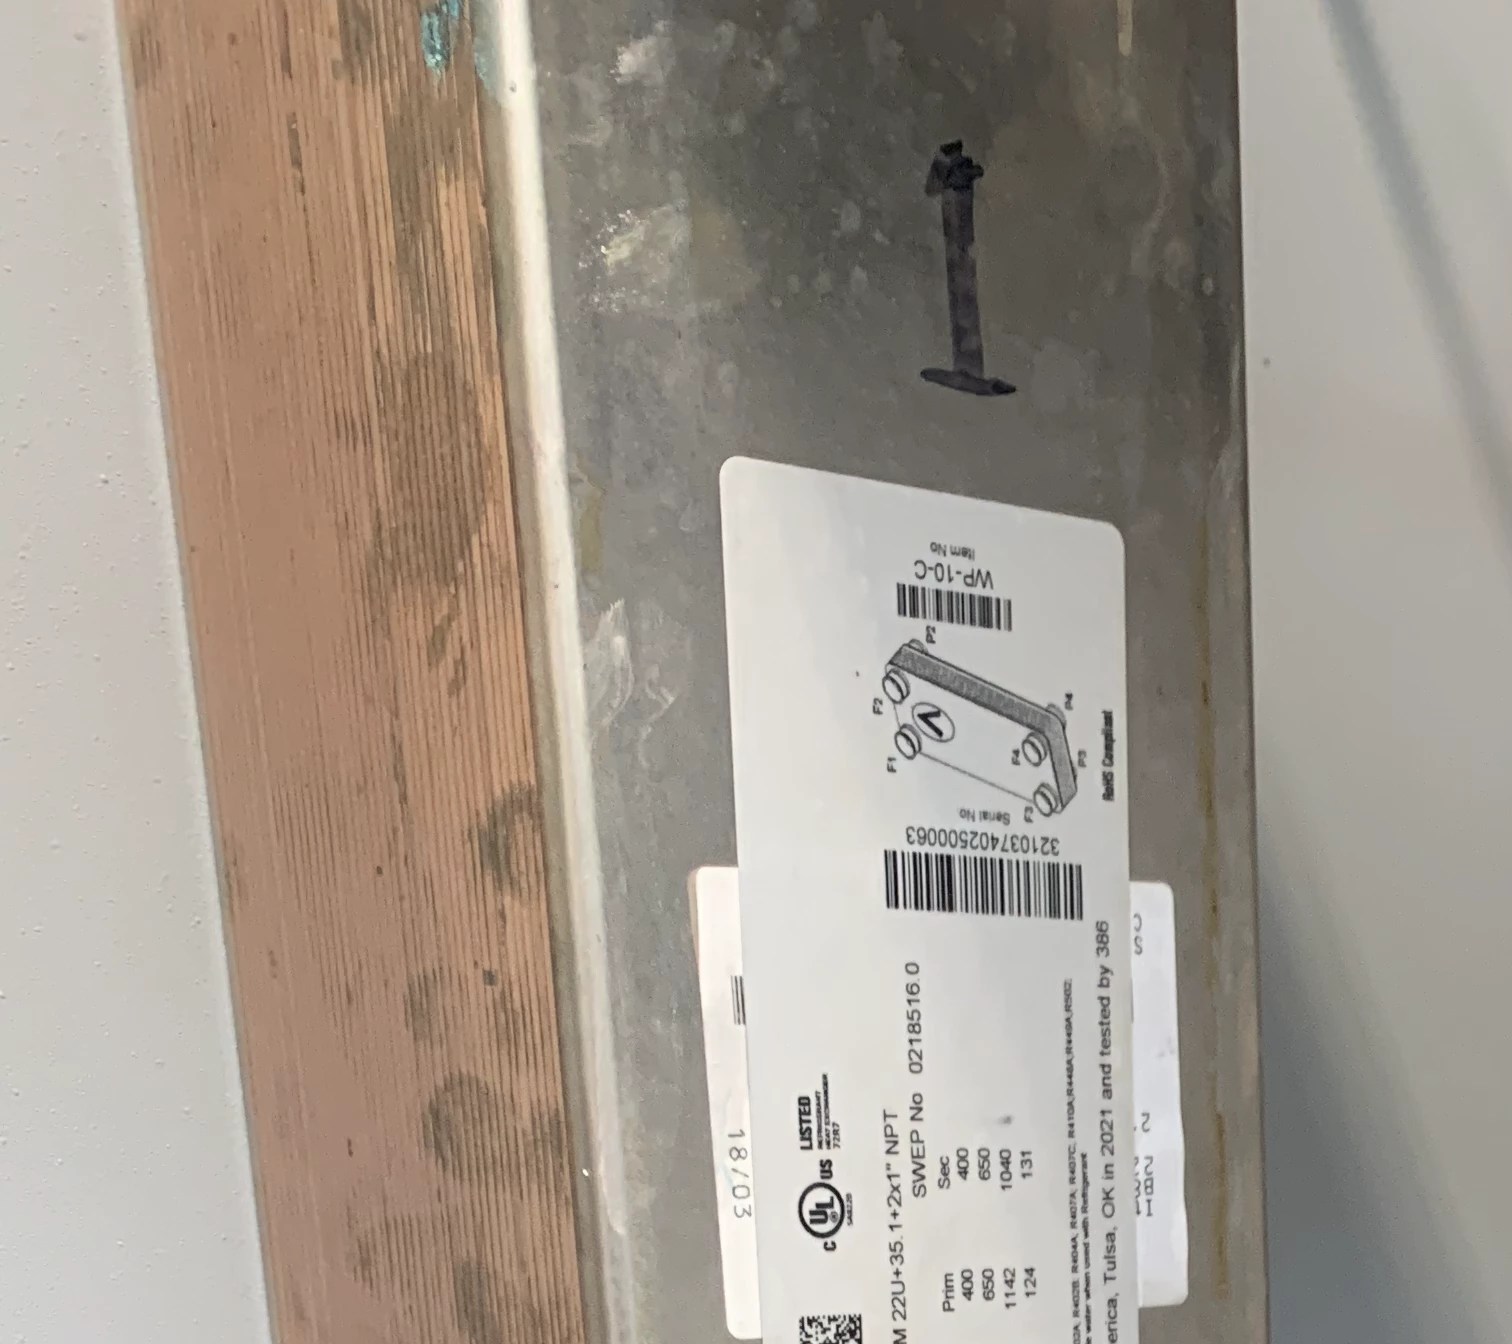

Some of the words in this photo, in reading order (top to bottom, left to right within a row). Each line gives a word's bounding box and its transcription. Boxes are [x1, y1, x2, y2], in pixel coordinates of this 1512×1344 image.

[929, 541, 945, 555] No
[947, 545, 975, 560] Item
[914, 558, 993, 588] WP-10-C
[959, 808, 971, 821] No
[971, 810, 1011, 825] Serial
[905, 824, 1060, 855] 321037402500063
[1095, 919, 1110, 957] 386
[1096, 964, 1114, 988] by
[904, 961, 923, 1073] 0218516.0
[1097, 995, 1112, 1055] tested
[1099, 1062, 1113, 1099] and
[797, 1095, 813, 1149] LISTED
[909, 1092, 924, 1121] No
[883, 1107, 900, 1154] NPT
[1100, 1108, 1115, 1156] 2021
[910, 1128, 927, 1197] SWEP
[937, 1155, 950, 1189] Sec
[956, 1146, 969, 1180] 400
[977, 1146, 991, 1180] 650
[999, 1148, 1013, 1190] 1040
[1020, 1149, 1033, 1179] 131
[1101, 1162, 1115, 1179] in
[1101, 1185, 1116, 1218] OK
[1103, 1225, 1118, 1283] Tulsa,
[942, 1272, 955, 1311] Prim
[960, 1267, 974, 1300] 400
[981, 1267, 995, 1300] 650
[1003, 1266, 1017, 1308] 1142
[1024, 1266, 1037, 1297] 124
[1082, 1271, 1091, 1299] when
